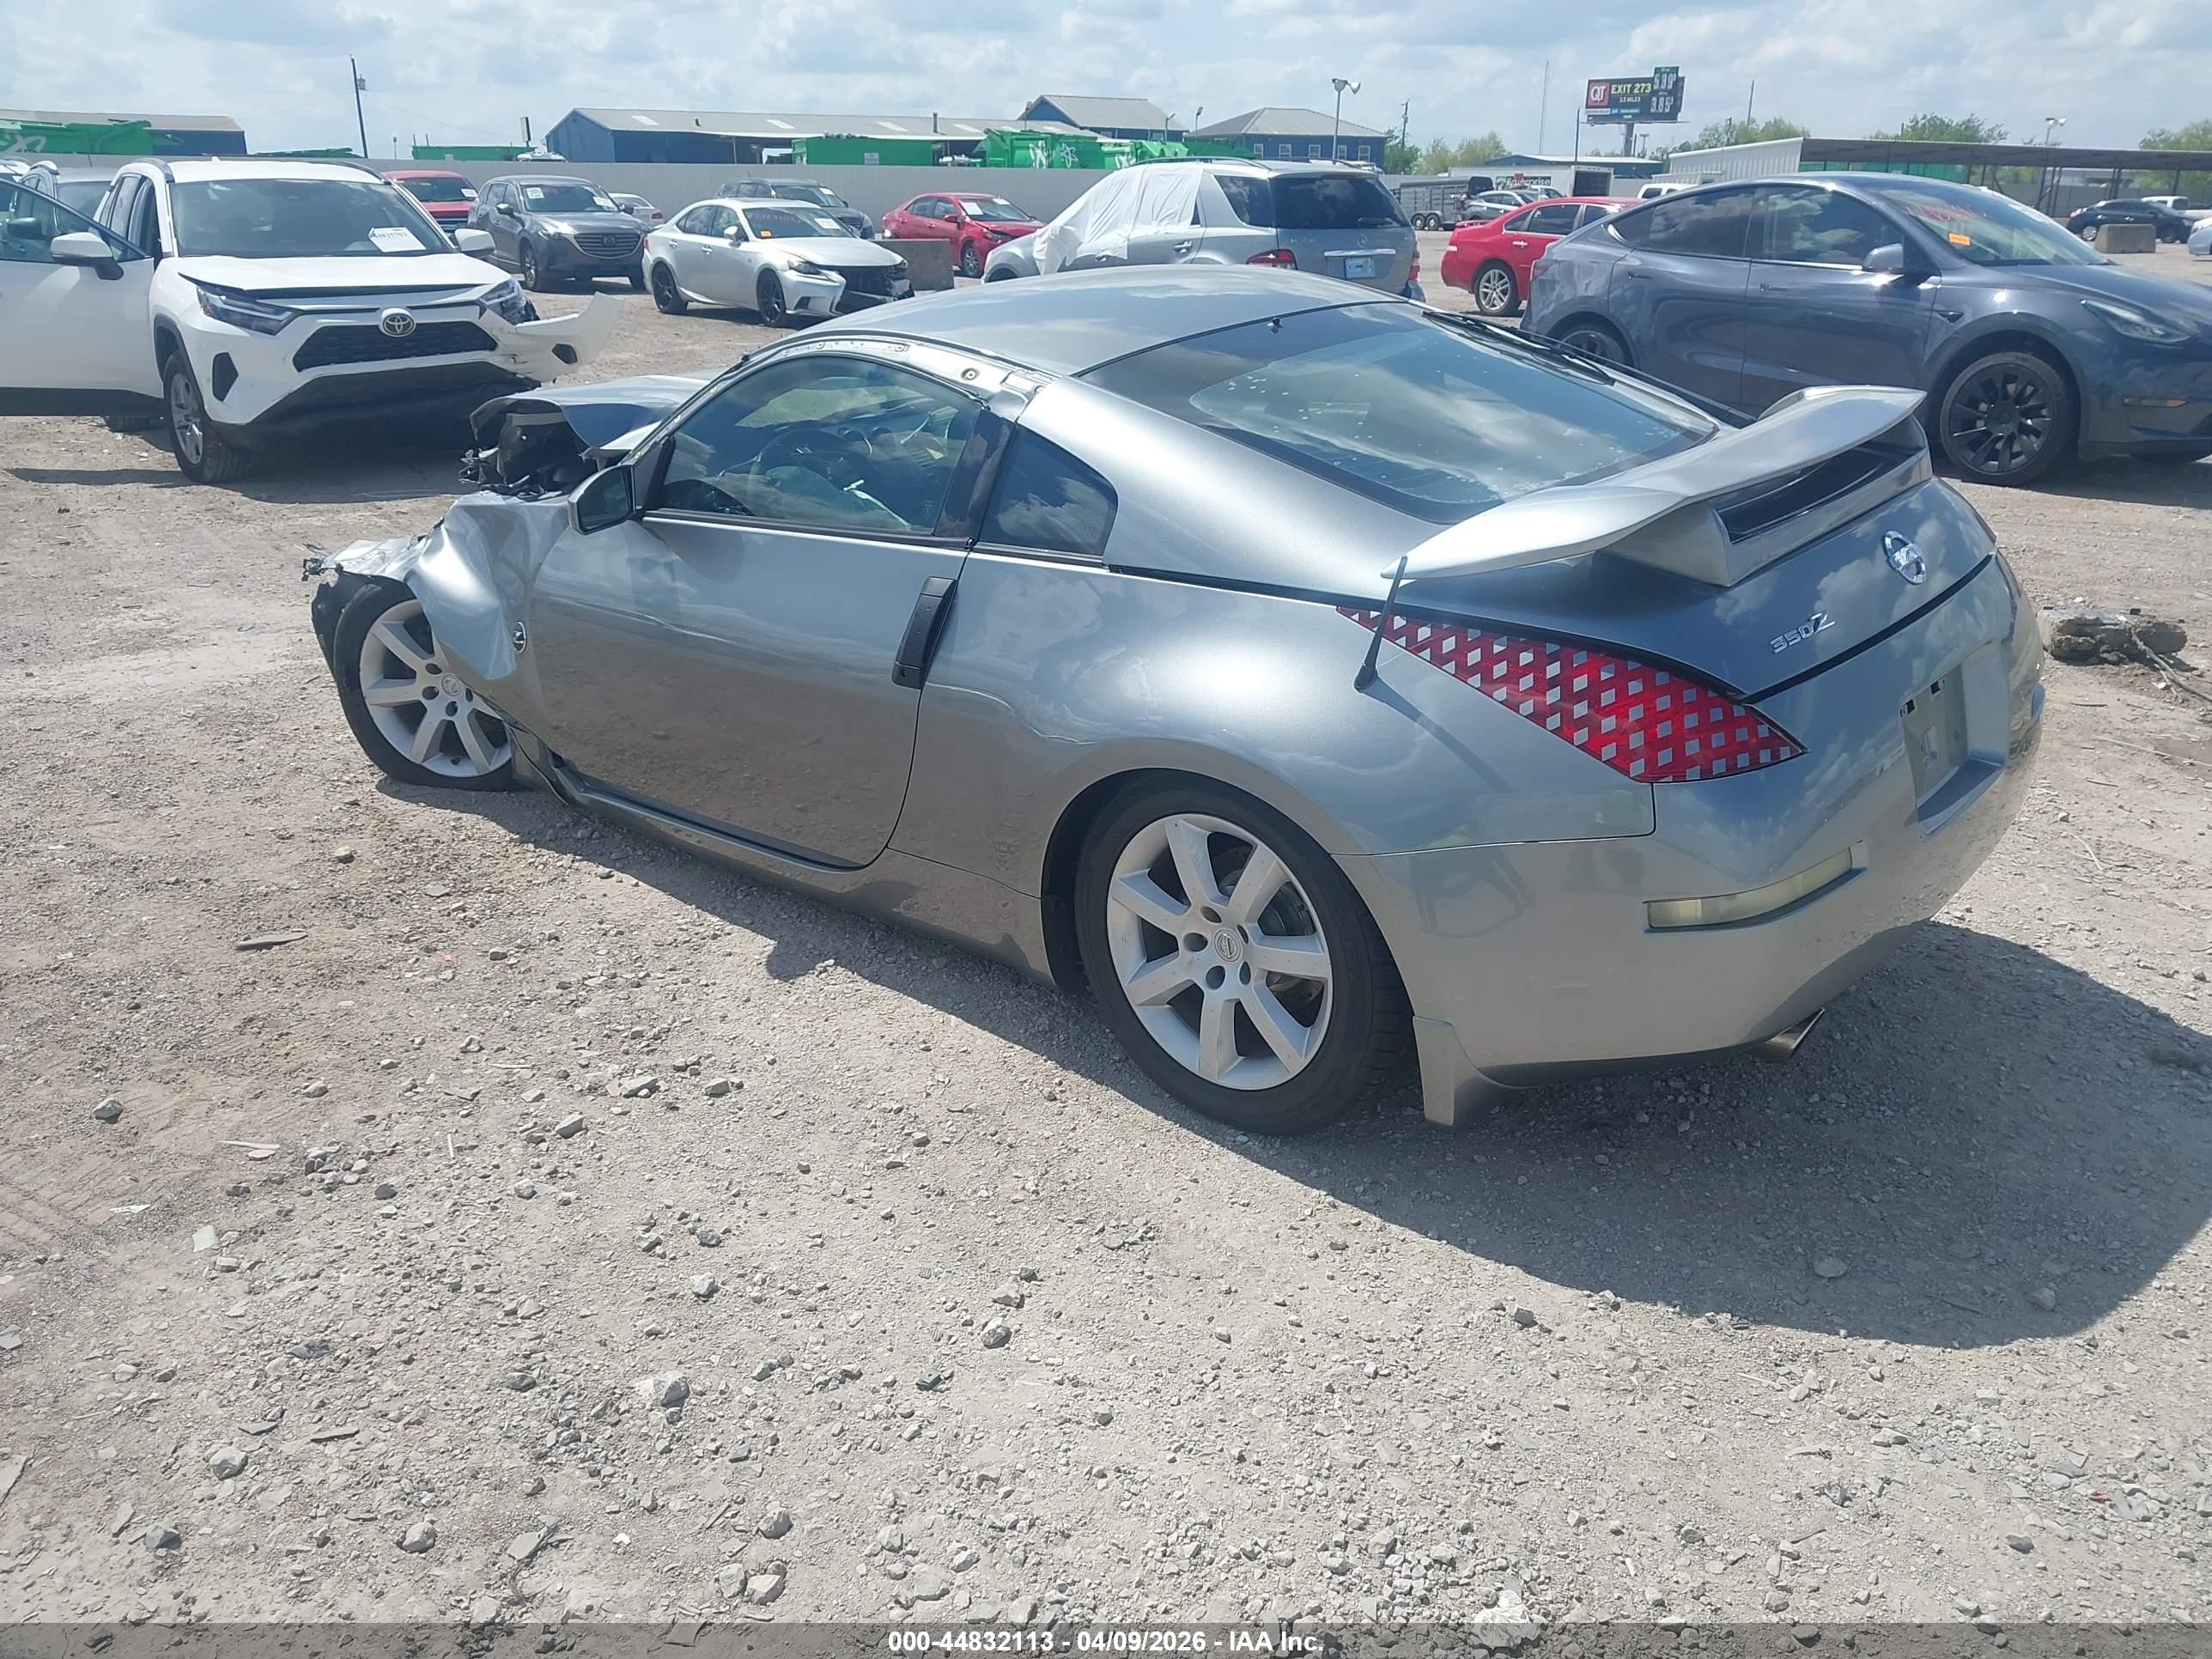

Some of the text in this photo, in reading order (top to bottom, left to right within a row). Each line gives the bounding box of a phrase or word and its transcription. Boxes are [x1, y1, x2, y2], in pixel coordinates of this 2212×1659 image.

[1590, 85, 1607, 101] QT
[1611, 82, 1652, 94] EXIT 273
[1770, 611, 1836, 653] 350Z
